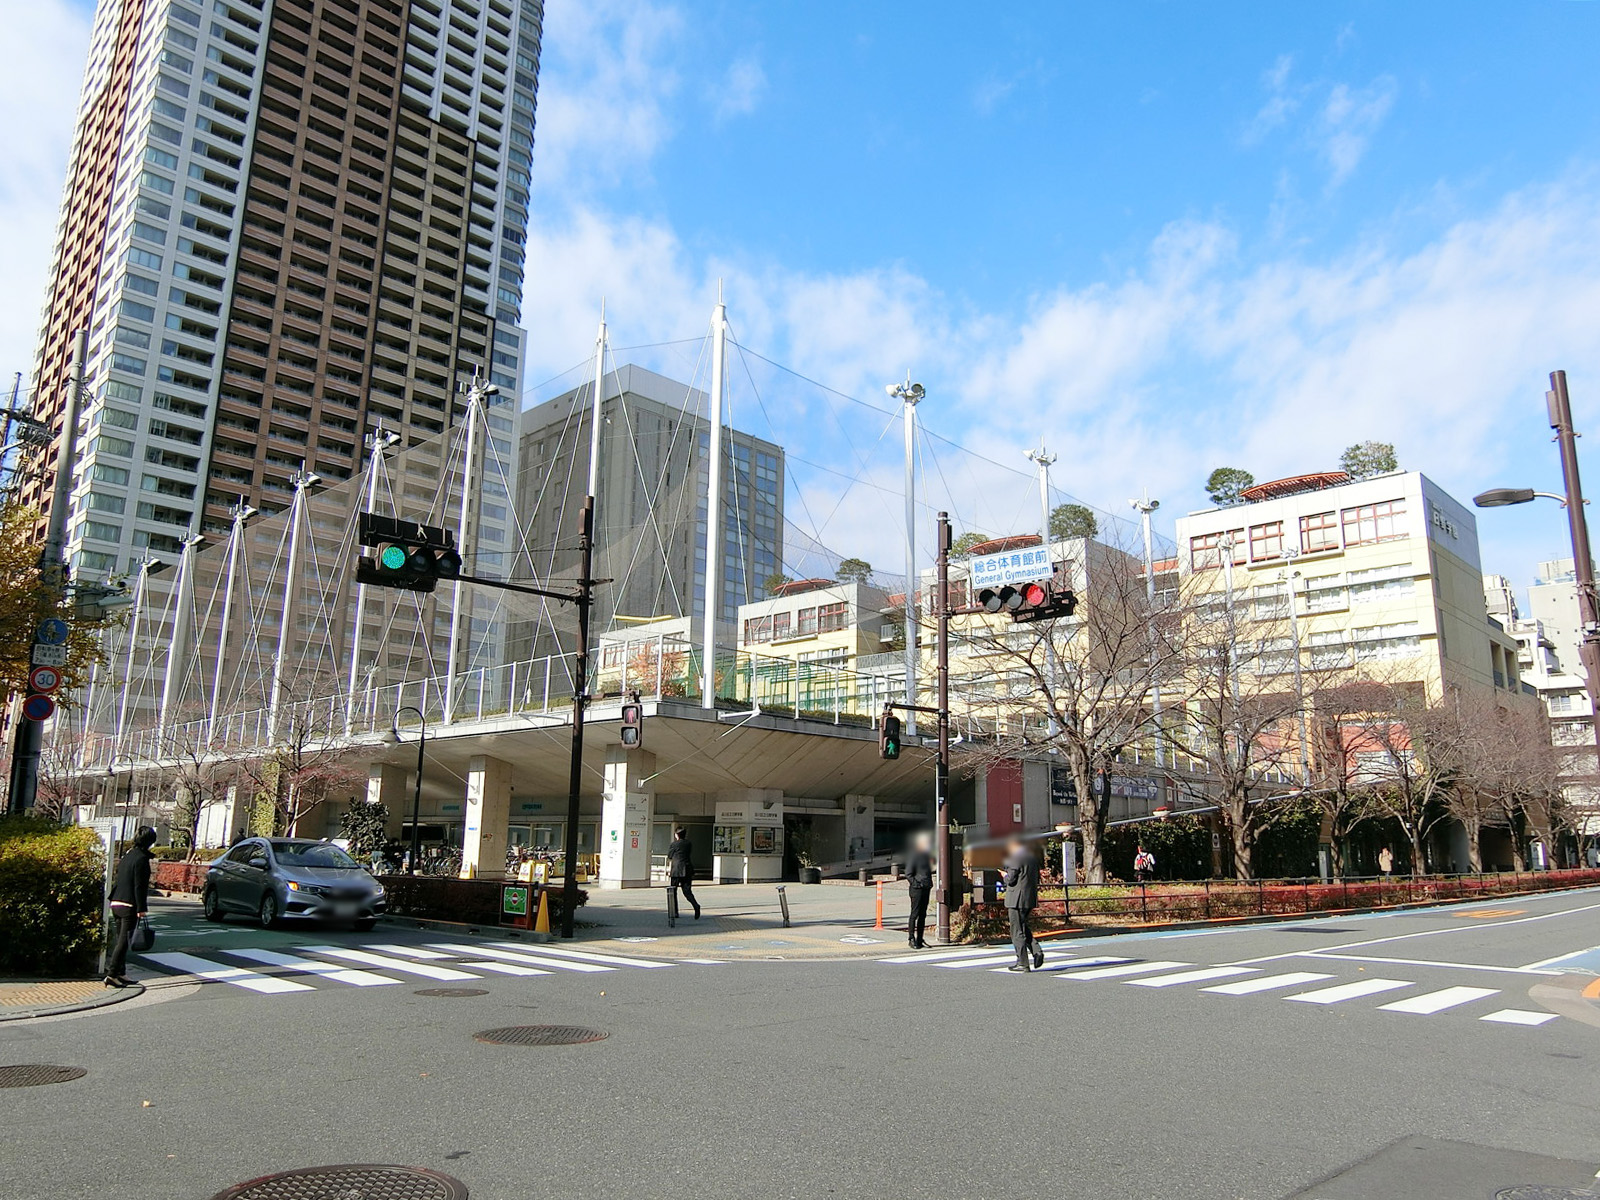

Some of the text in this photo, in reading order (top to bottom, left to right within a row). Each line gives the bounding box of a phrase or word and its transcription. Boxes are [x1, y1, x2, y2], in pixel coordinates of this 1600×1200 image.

[974, 550, 1047, 573] 総合体育館前
[974, 566, 1049, 585] General Gymnasium
[37, 674, 54, 685] 30
